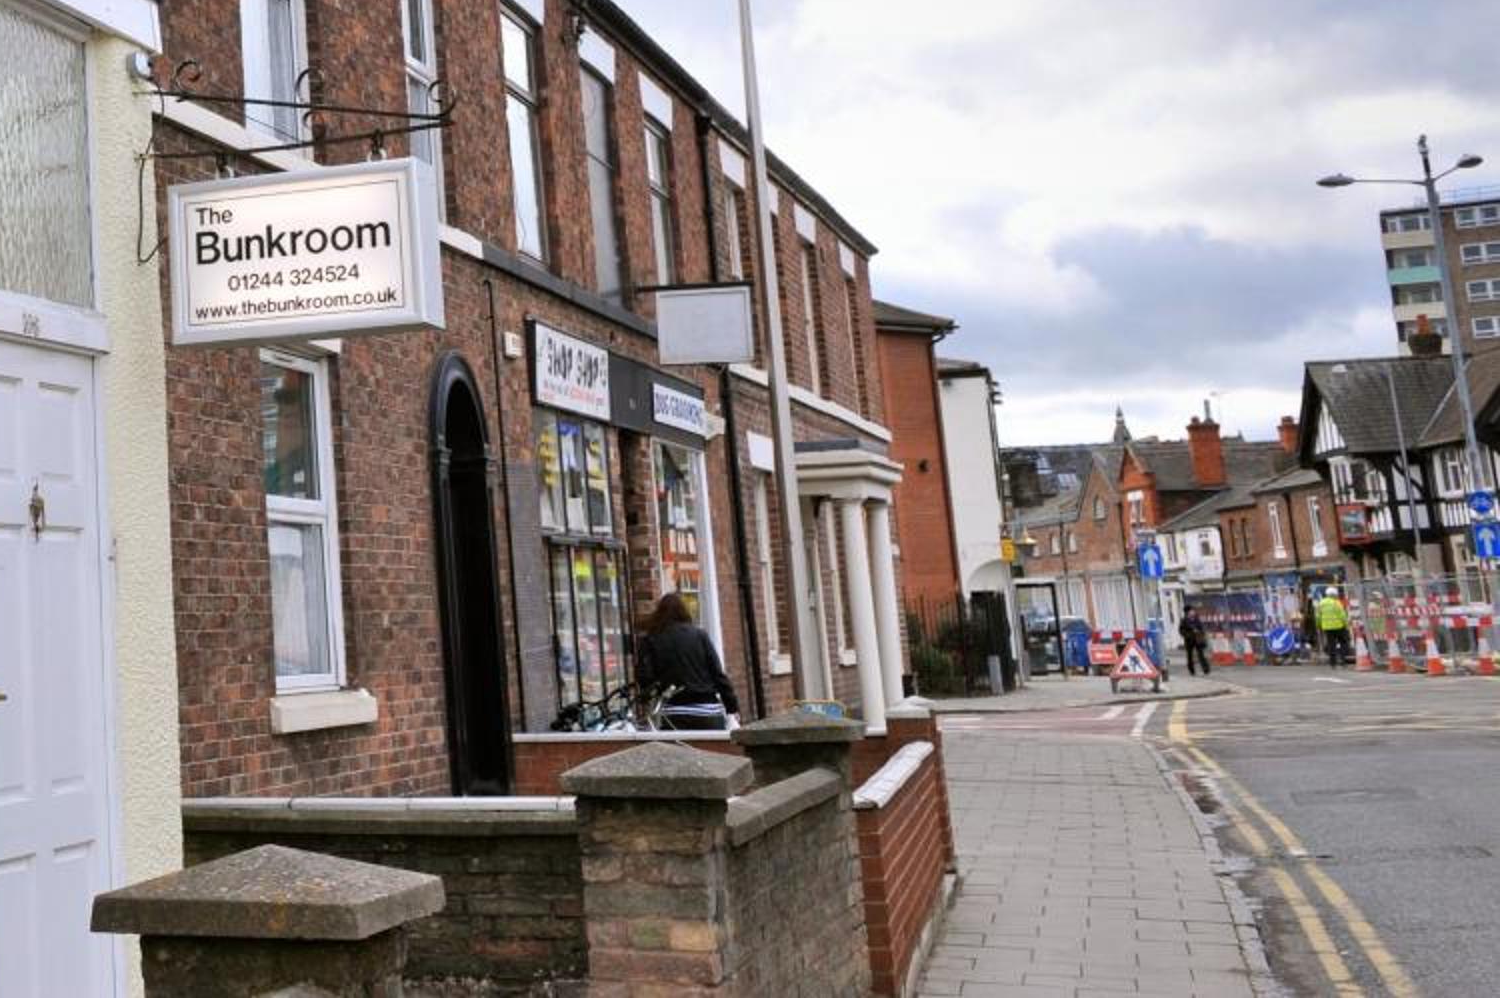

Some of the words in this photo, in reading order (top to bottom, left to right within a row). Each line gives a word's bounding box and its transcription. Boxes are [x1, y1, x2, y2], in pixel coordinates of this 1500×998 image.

[195, 207, 233, 227] The
[195, 221, 392, 265] Bunkroom
[228, 272, 284, 292] 01244
[289, 263, 360, 284] 324524
[195, 287, 398, 320] www.thebunkroom.co.uk
